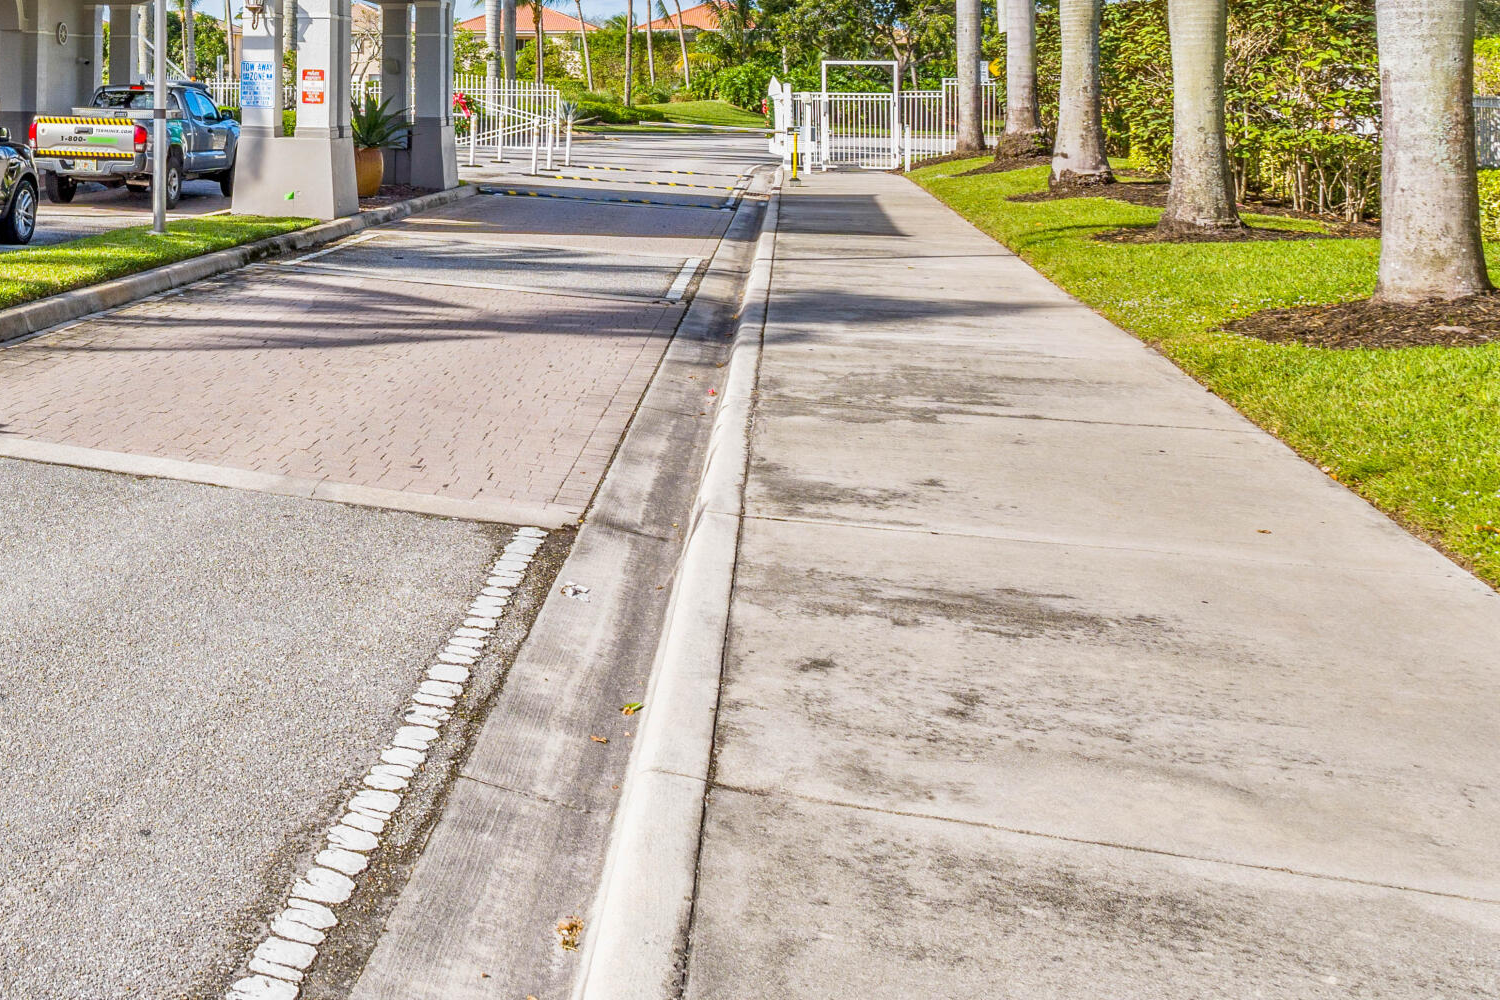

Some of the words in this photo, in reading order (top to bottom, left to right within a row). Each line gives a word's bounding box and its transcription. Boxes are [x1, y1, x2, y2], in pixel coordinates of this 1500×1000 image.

[242, 62, 254, 71] TOW
[258, 63, 273, 71] AWAY
[249, 72, 266, 81] ZONE
